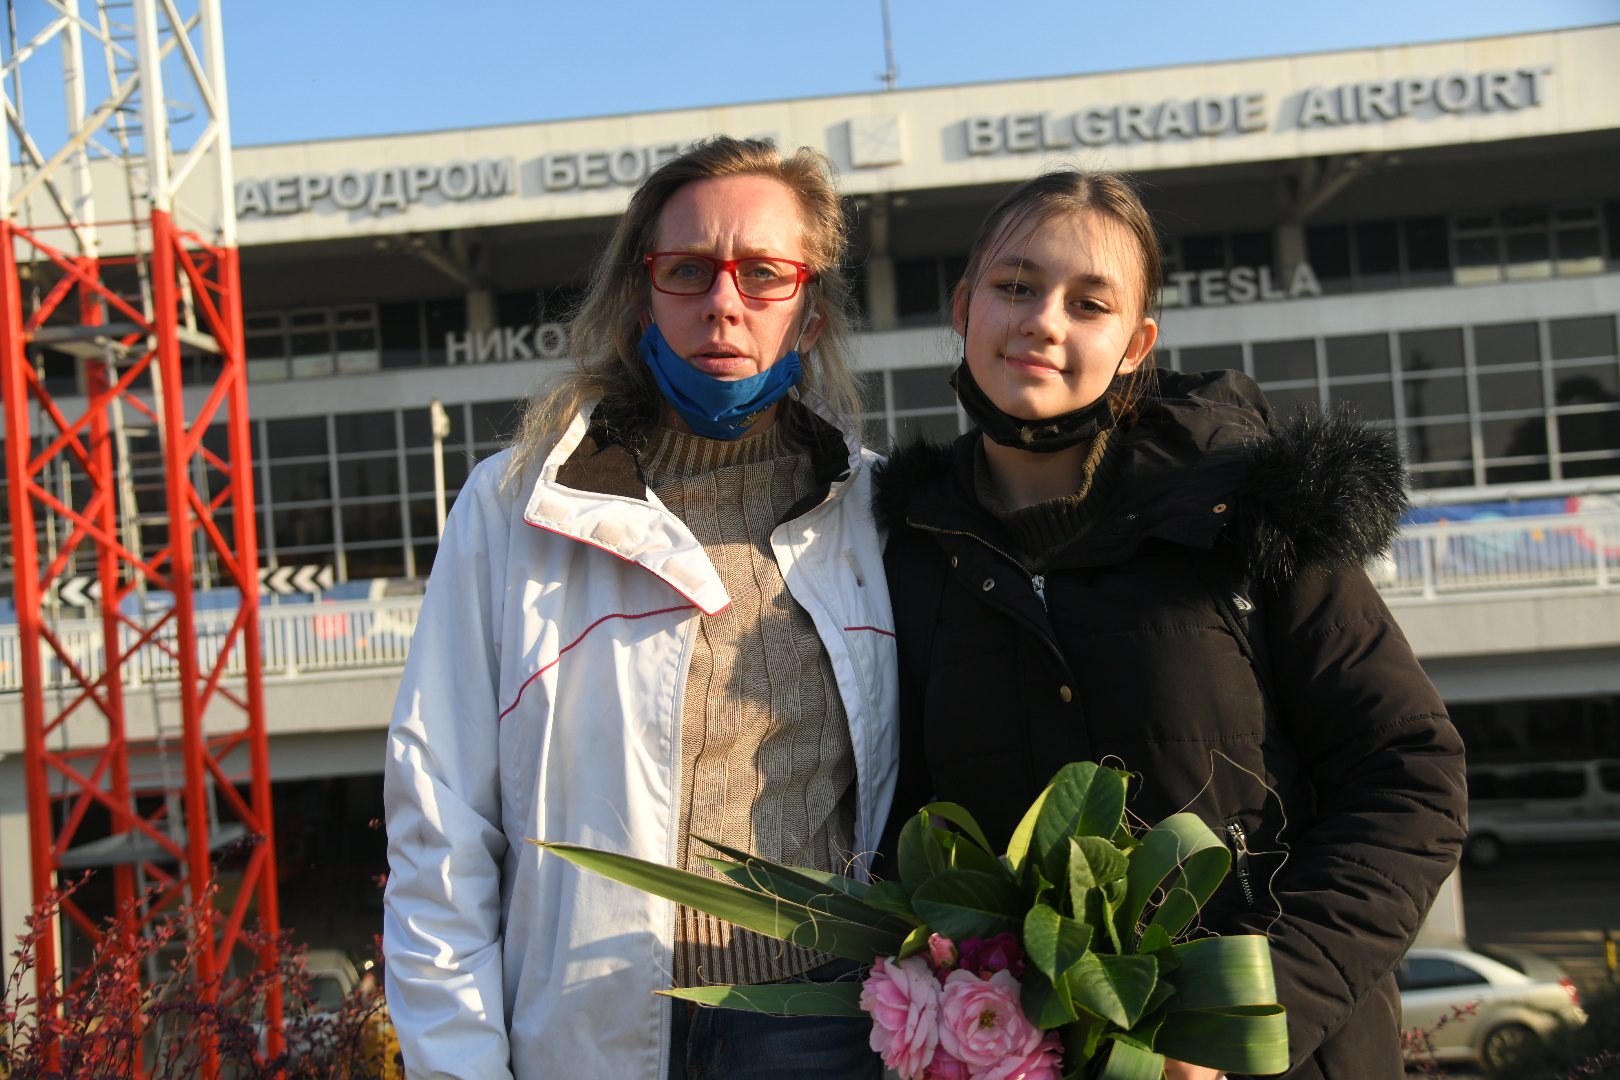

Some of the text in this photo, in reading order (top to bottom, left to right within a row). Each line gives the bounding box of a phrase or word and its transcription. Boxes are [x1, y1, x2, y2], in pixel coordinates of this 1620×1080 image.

[965, 66, 1555, 156] BELGRADE AIRPORT
[236, 145, 679, 219] АЕРОДРОМ БЕОГ
[1167, 262, 1322, 306] TESLA
[445, 322, 567, 365] НИКО
